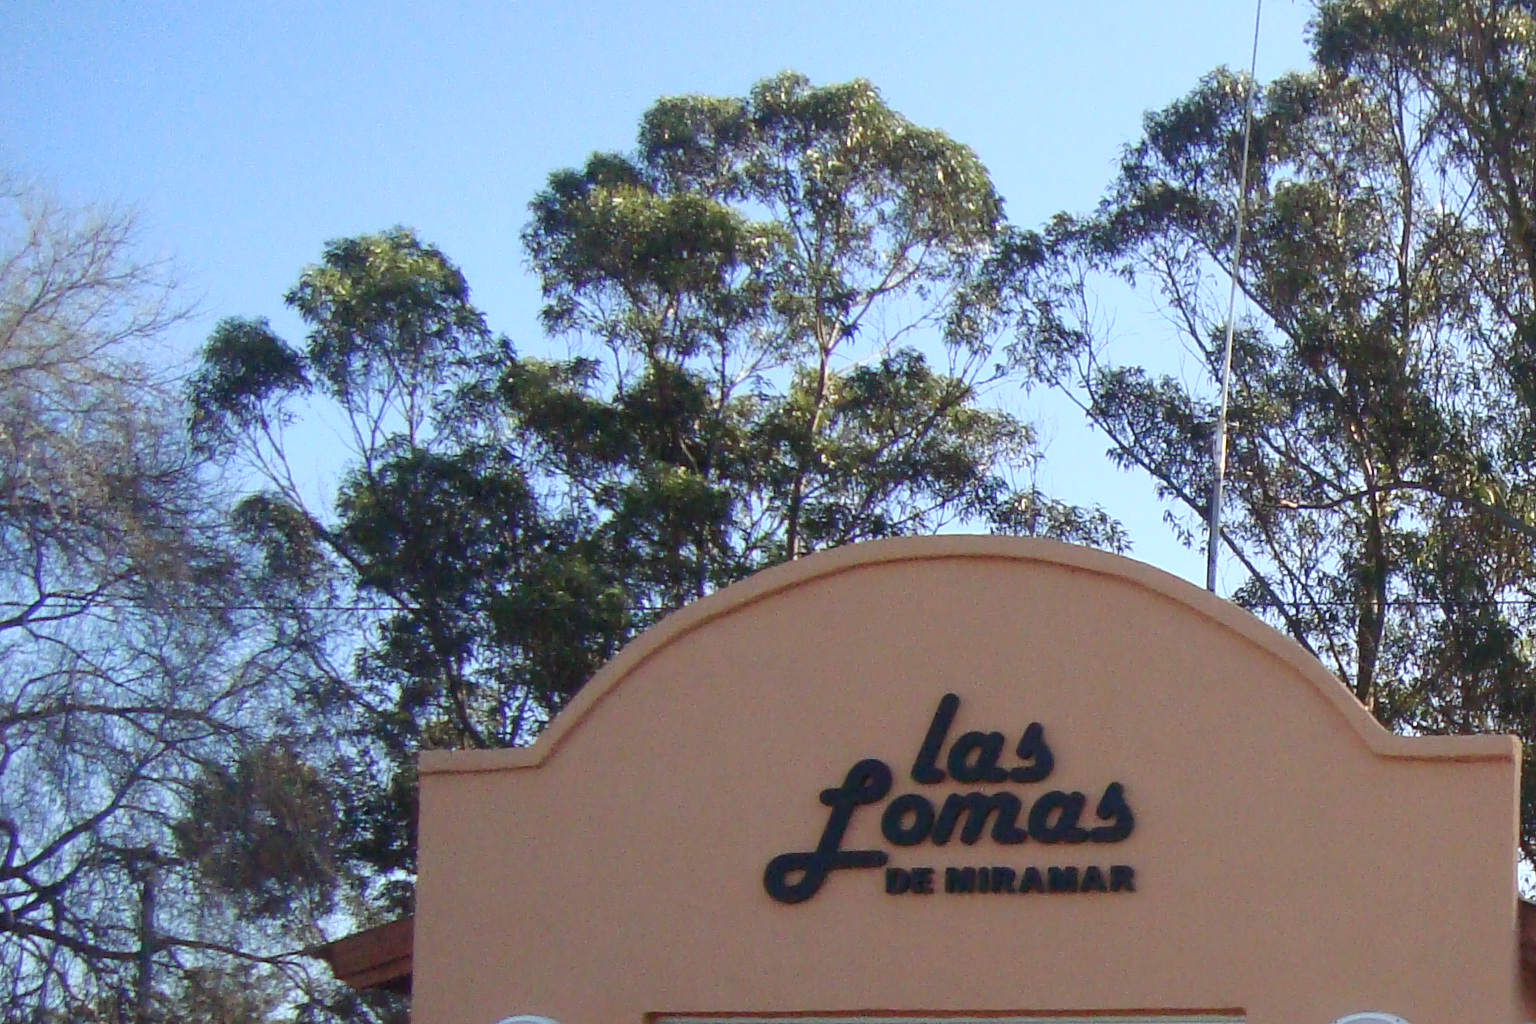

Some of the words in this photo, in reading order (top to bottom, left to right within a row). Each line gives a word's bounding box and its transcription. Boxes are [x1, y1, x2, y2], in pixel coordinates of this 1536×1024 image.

[910, 692, 1055, 784] las
[764, 758, 1135, 904] Lomas
[885, 867, 935, 894] DE
[945, 864, 1136, 894] MIRAMAR
